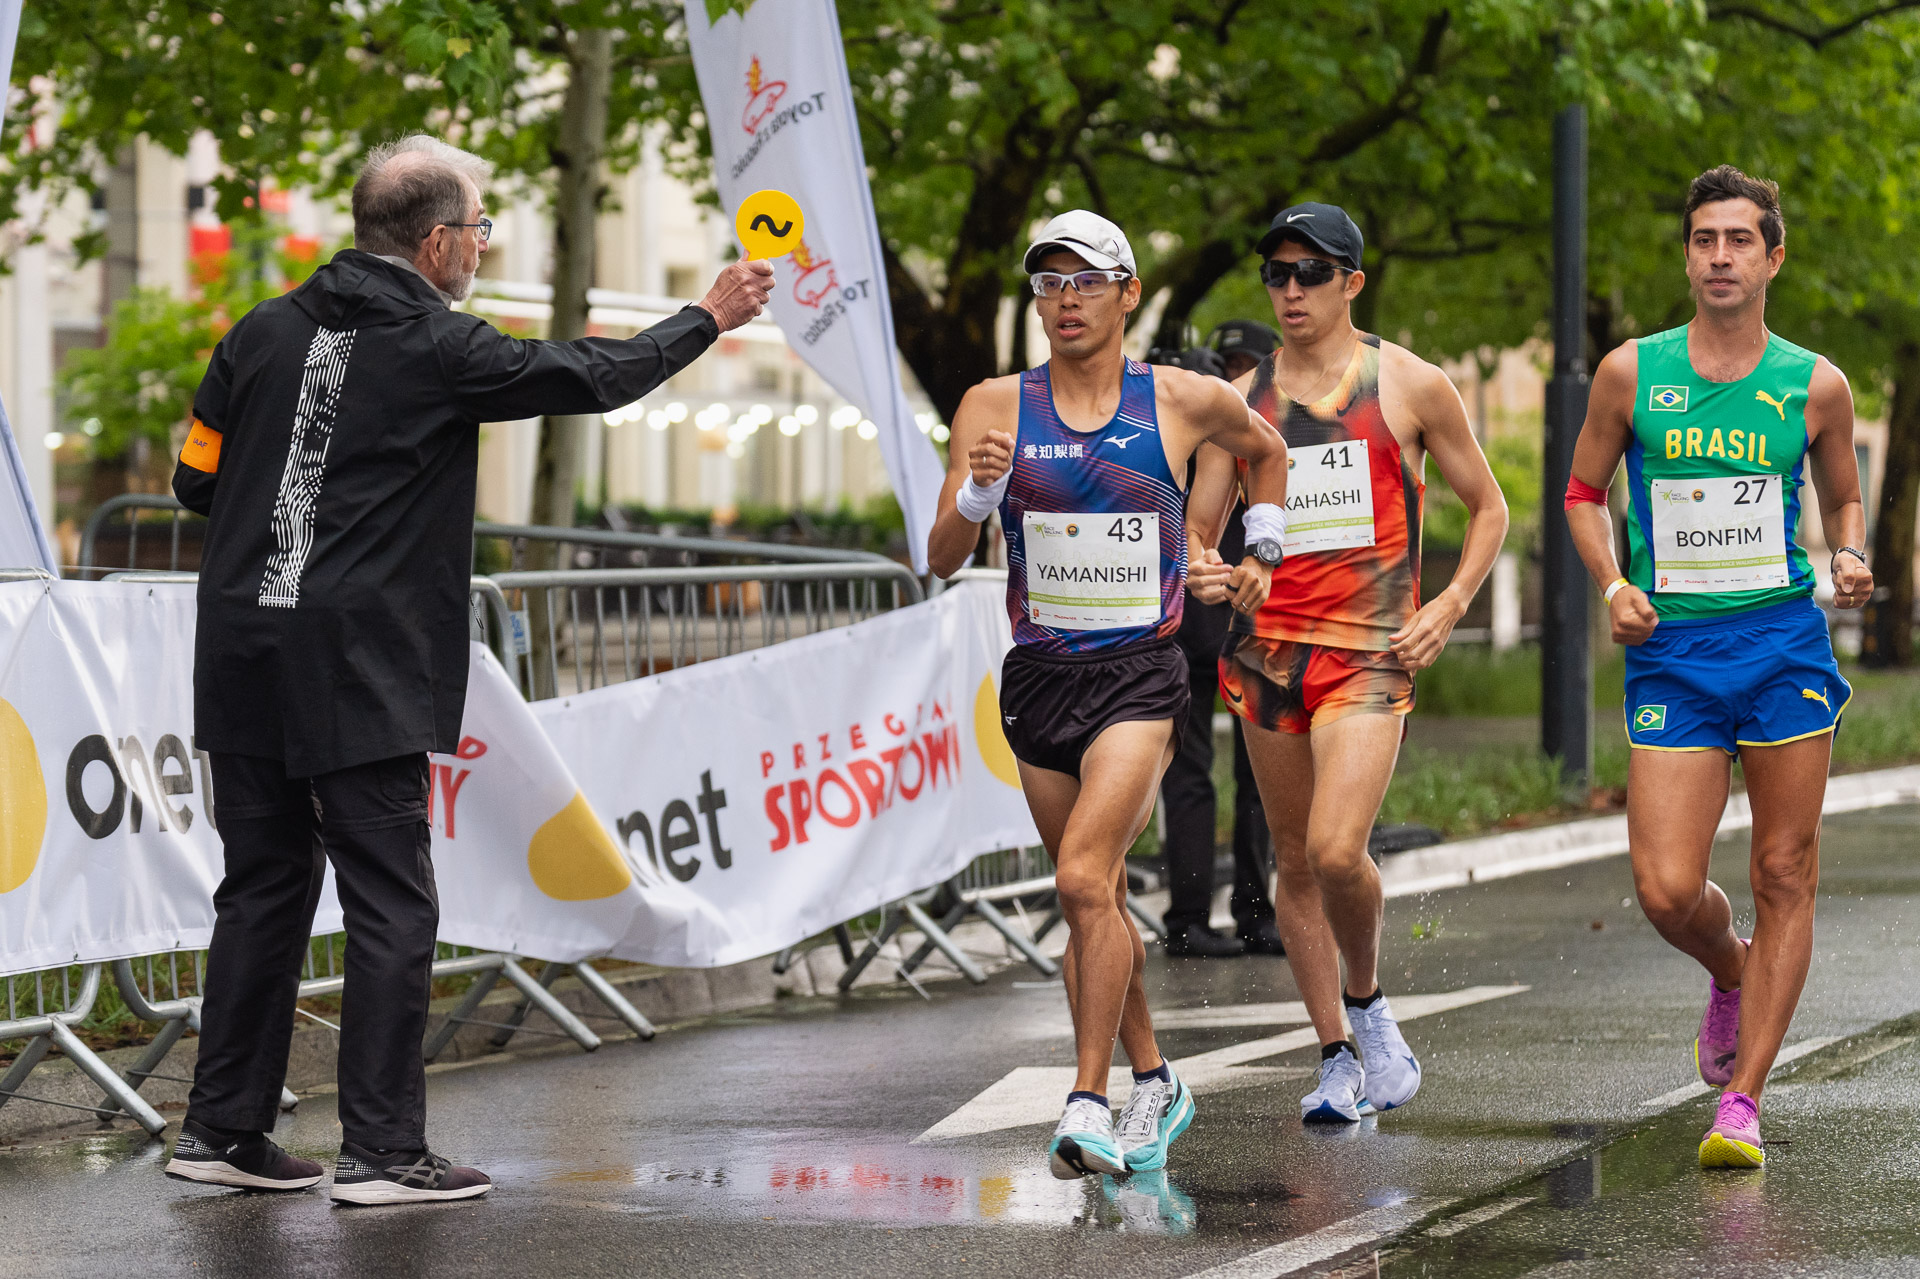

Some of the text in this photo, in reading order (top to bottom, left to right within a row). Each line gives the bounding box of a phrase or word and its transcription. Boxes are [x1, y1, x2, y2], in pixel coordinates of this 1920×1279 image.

[1023, 443, 1083, 459] 愛知製鋼
[1320, 445, 1354, 470] 41
[1665, 427, 1772, 467] BRASIL
[1733, 478, 1768, 505] 27
[1107, 517, 1143, 543] 43
[1676, 526, 1762, 548] BONFIM
[1036, 562, 1147, 583] YAMANISHI
[65, 733, 216, 840] onet
